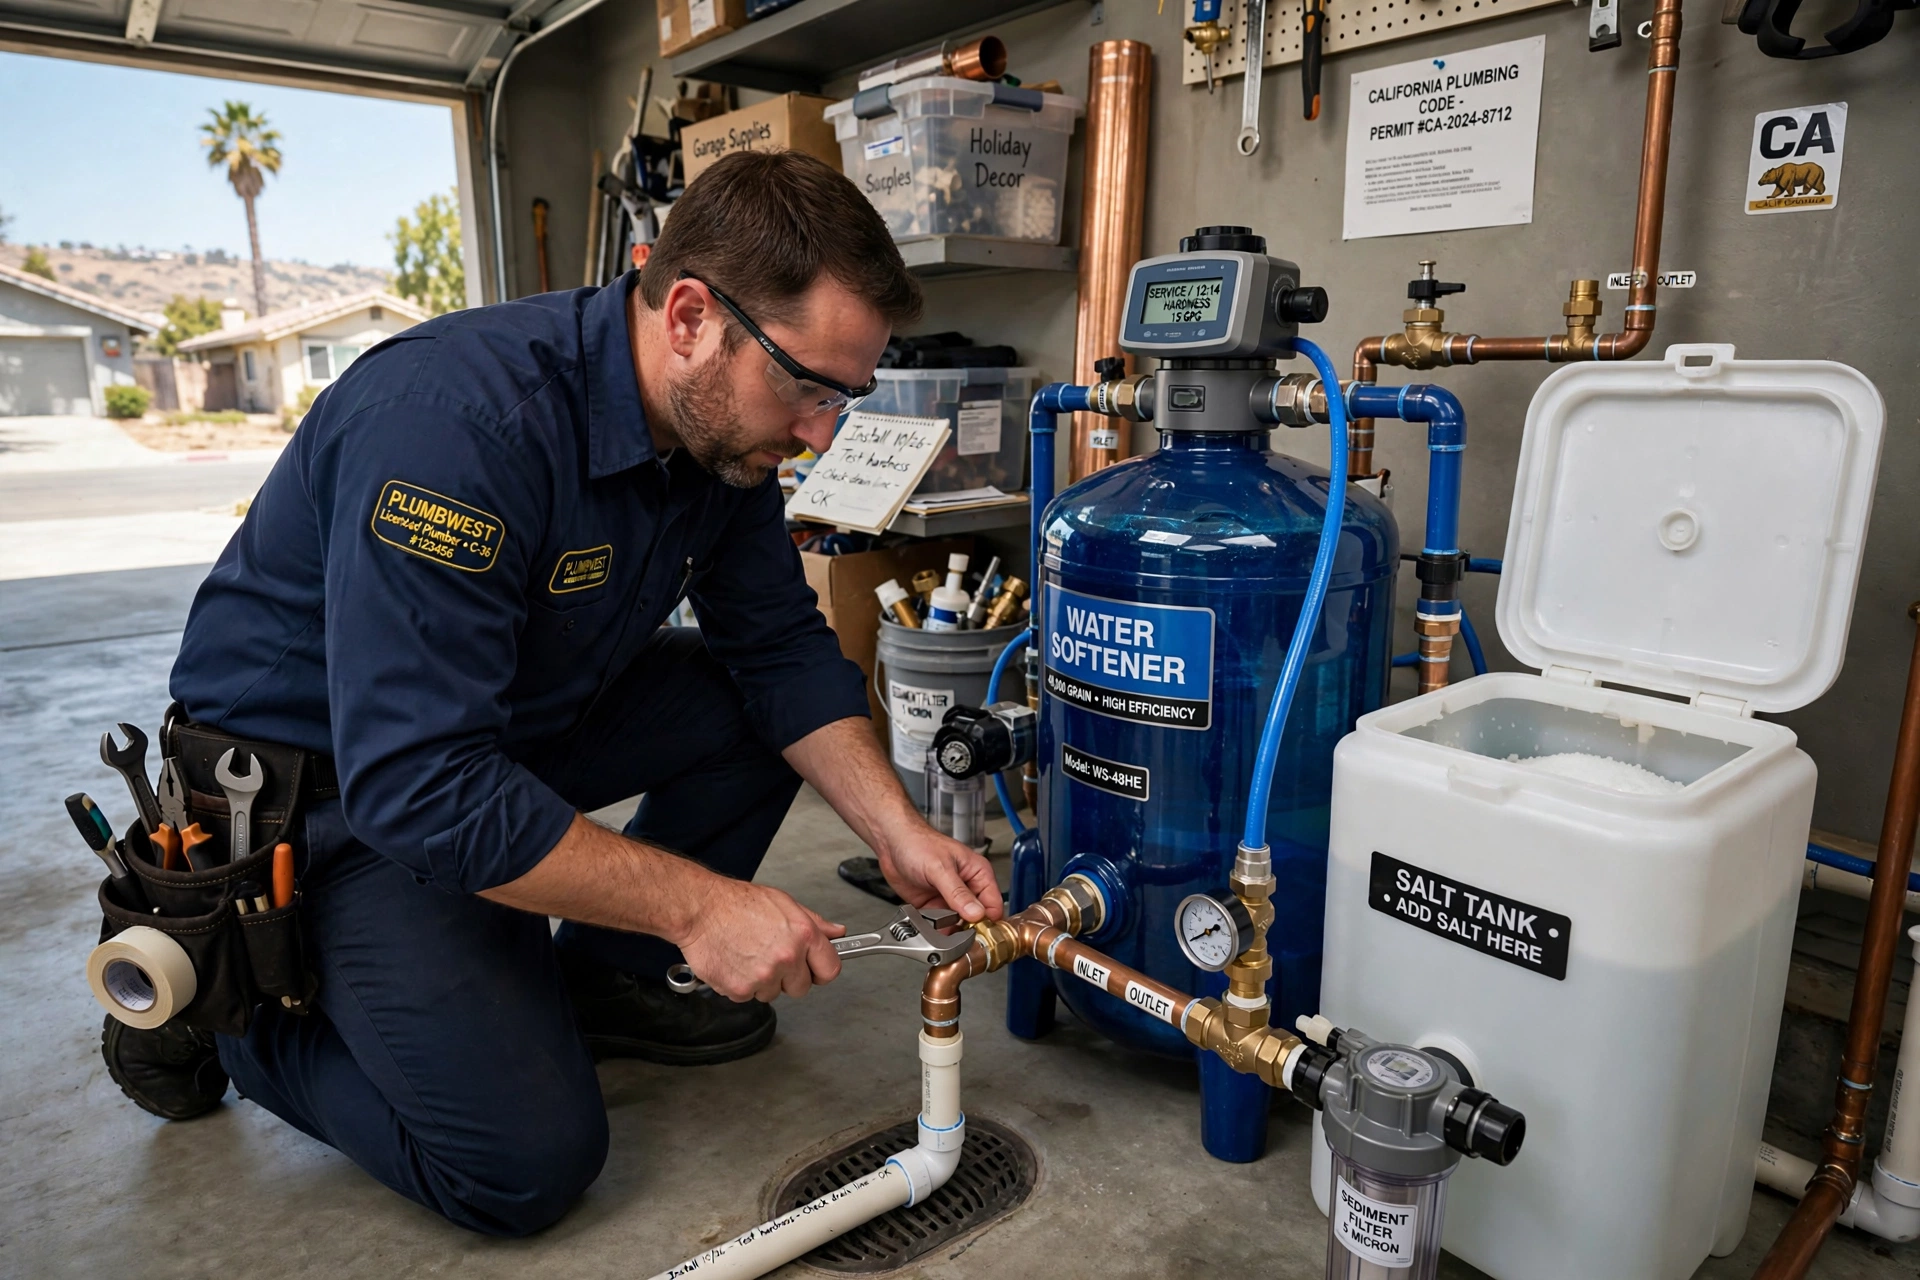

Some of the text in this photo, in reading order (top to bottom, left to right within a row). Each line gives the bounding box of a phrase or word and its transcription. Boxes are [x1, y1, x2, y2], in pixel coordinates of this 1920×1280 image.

[1368, 64, 1519, 103] CALIFORNIA PLUMBING
[1419, 95, 1455, 114] CODE
[1370, 106, 1512, 140] PERMIT #CA-2024-8712
[1760, 112, 1835, 159] CA
[693, 137, 727, 157] Garage
[970, 128, 1032, 168] Holiday
[974, 162, 1025, 187] Decor
[1149, 286, 1187, 298] SERVICE
[1197, 284, 1220, 297] 12:14
[1657, 274, 1693, 286] OUTLET
[1184, 311, 1202, 321] GPG
[845, 425, 892, 445] Install
[838, 448, 863, 464] Test
[388, 489, 496, 541] PLUMBWEST
[811, 490, 835, 507] OK
[409, 534, 454, 558] #123456
[422, 523, 463, 546] Plumber
[470, 541, 492, 557] C-36
[1066, 605, 1155, 649] WATER
[1052, 631, 1186, 684] SOFTENER
[1067, 684, 1092, 702] GRAIN
[1102, 695, 1126, 711] HIGH
[1128, 700, 1196, 720] EFFICIENCY
[1065, 752, 1142, 789] Model: WS-48HE
[1396, 869, 1538, 940] SALT TANK
[1396, 897, 1542, 964] ADD SALT HERE
[1077, 960, 1169, 1016] INLET OUTLET
[666, 1259, 699, 1280] Install
[735, 1232, 755, 1247] Test
[802, 1199, 829, 1214] Check
[878, 1168, 892, 1179] OK
[1342, 1190, 1409, 1226] SEDIMENT
[1343, 1222, 1399, 1254] 5 MICRON
[1349, 1211, 1393, 1240] FILTER
